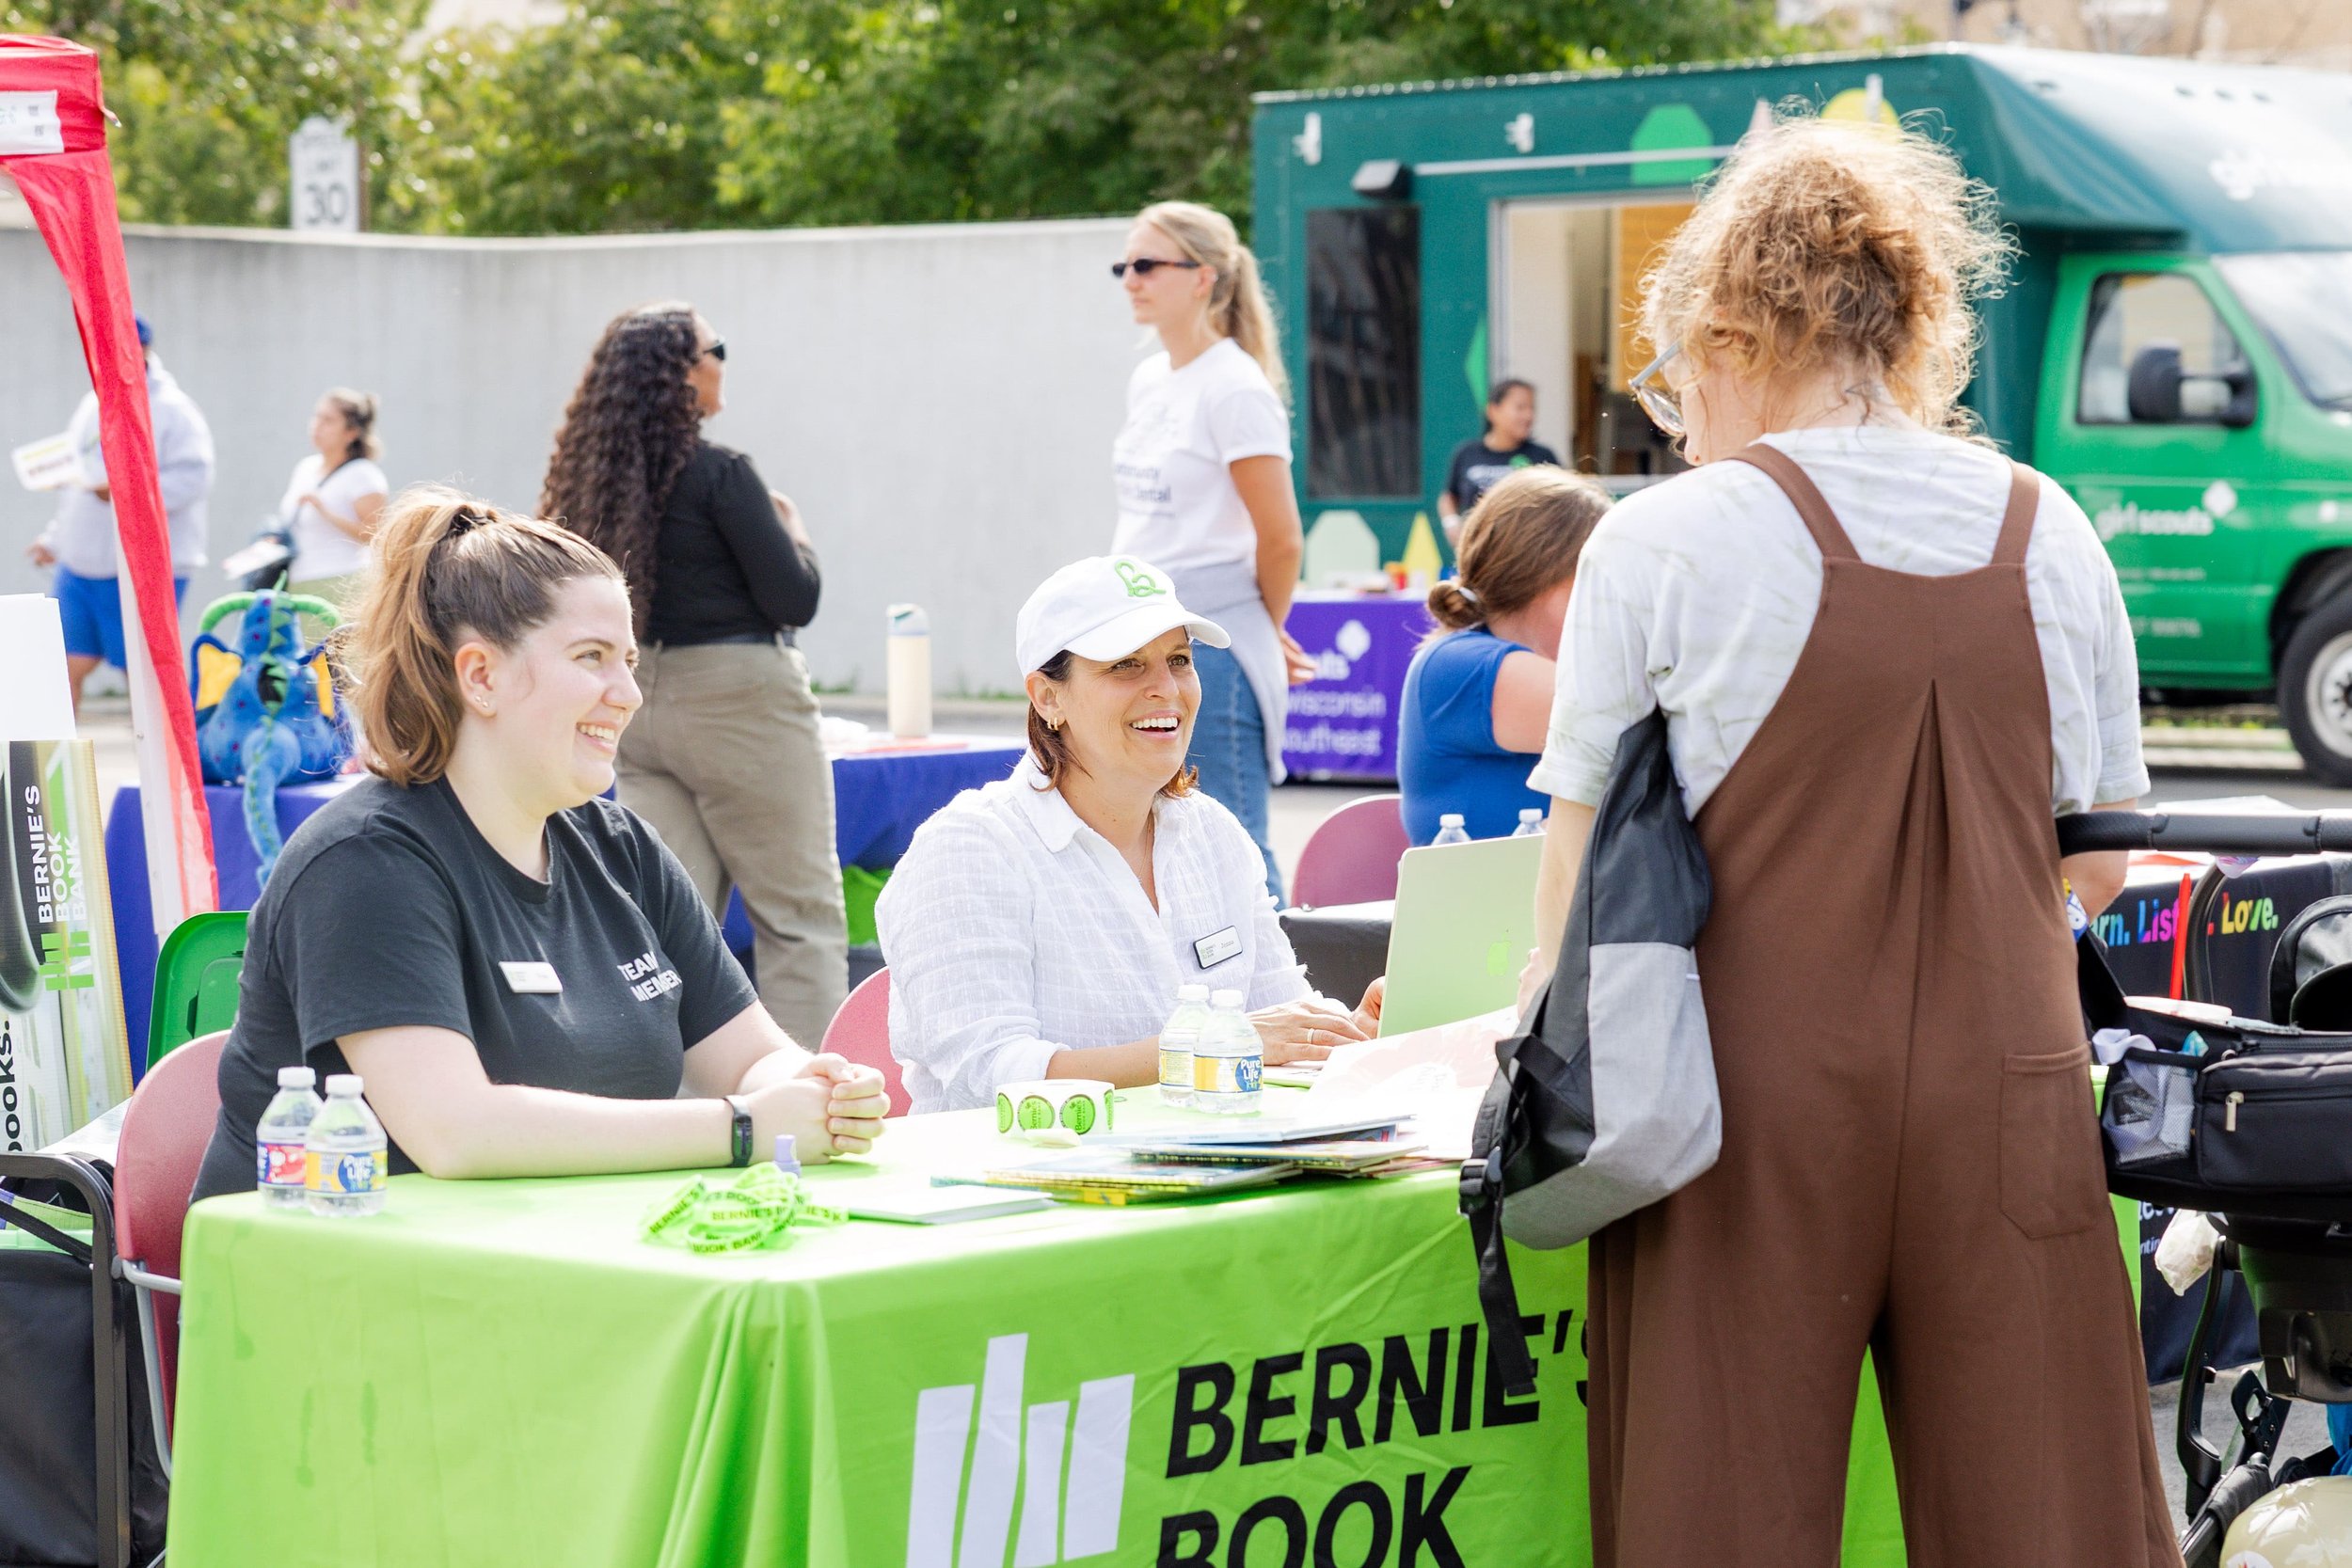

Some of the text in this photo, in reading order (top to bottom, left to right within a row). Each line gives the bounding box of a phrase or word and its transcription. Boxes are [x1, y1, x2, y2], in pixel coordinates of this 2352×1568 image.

[306, 183, 349, 226] 30
[1283, 721, 1382, 755] outheast
[25, 784, 54, 923] BERNIE'S
[47, 831, 71, 922] BOOK
[64, 834, 87, 921] BANK
[2221, 892, 2279, 934] Love.
[616, 951, 659, 981] TEAM
[1240, 1059, 1262, 1070] Pure
[1243, 1068, 1260, 1083] Life
[1156, 1465, 1472, 1568] BOOK
